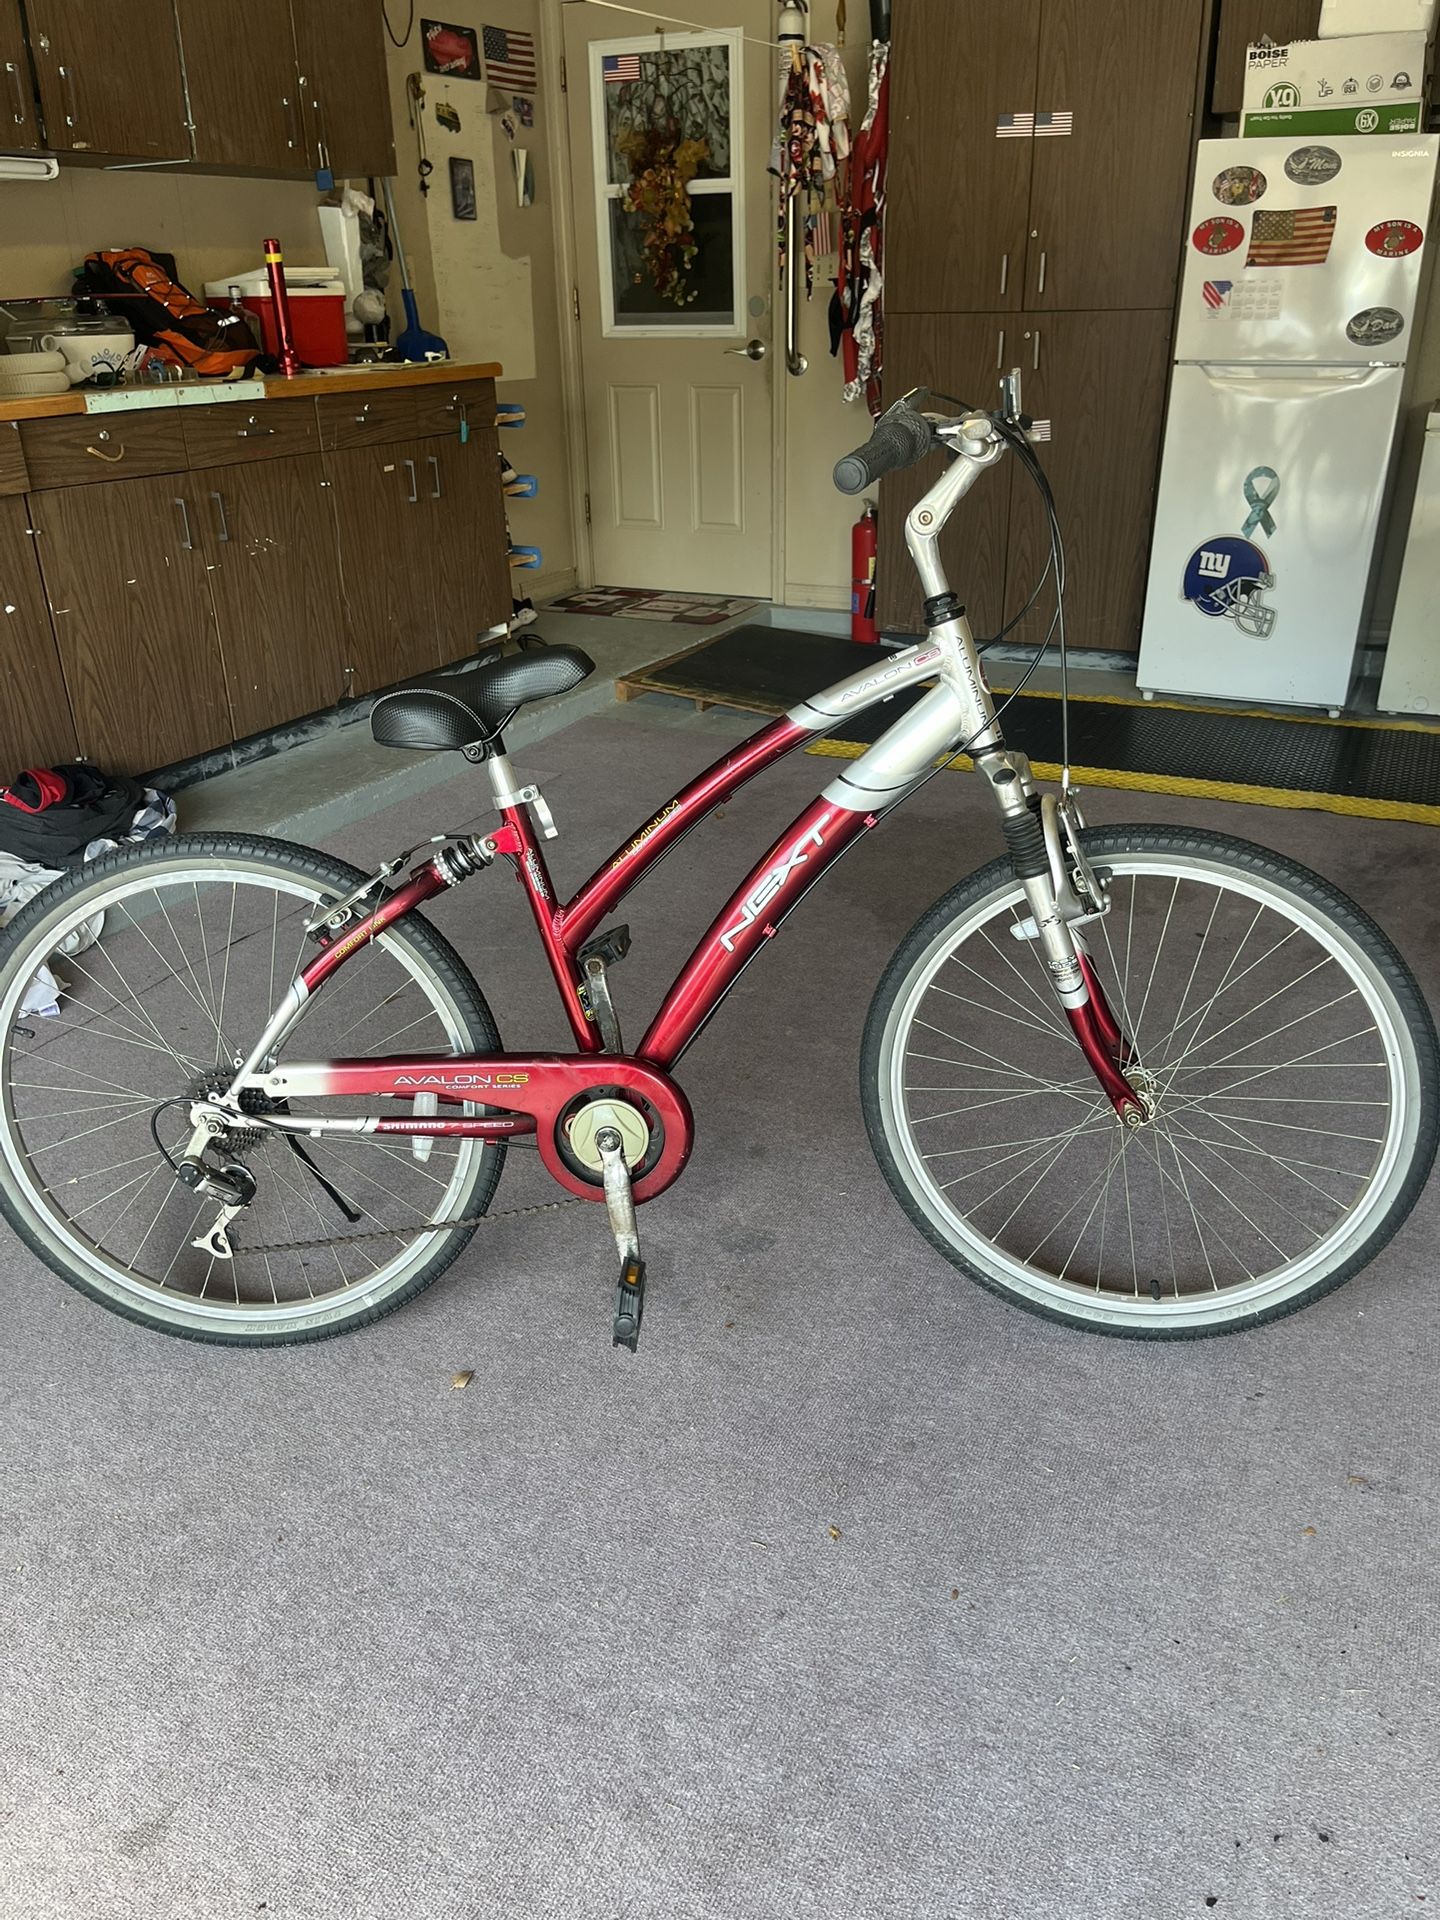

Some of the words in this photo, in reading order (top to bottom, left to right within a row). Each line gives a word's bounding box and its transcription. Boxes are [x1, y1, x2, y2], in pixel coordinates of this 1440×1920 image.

[1249, 48, 1289, 60] BOISE
[1247, 57, 1289, 71] PAPER
[1388, 123, 1416, 132] BOISE
[1391, 150, 1430, 158] INSIGNIA
[1309, 157, 1338, 170] Mom
[1373, 223, 1385, 233] MY
[1387, 221, 1403, 229] SON
[1375, 248, 1409, 257] MARINE
[1370, 318, 1399, 331] Dad
[841, 662, 912, 702] AVALON
[612, 799, 679, 869] ALUMINUM
[526, 847, 551, 900] ALUMINUM
[720, 813, 832, 952] NEXT
[335, 929, 368, 959] COMFORT
[394, 1074, 492, 1085] AVALON
[496, 1073, 530, 1084] CS
[462, 1121, 515, 1129] SPEED
